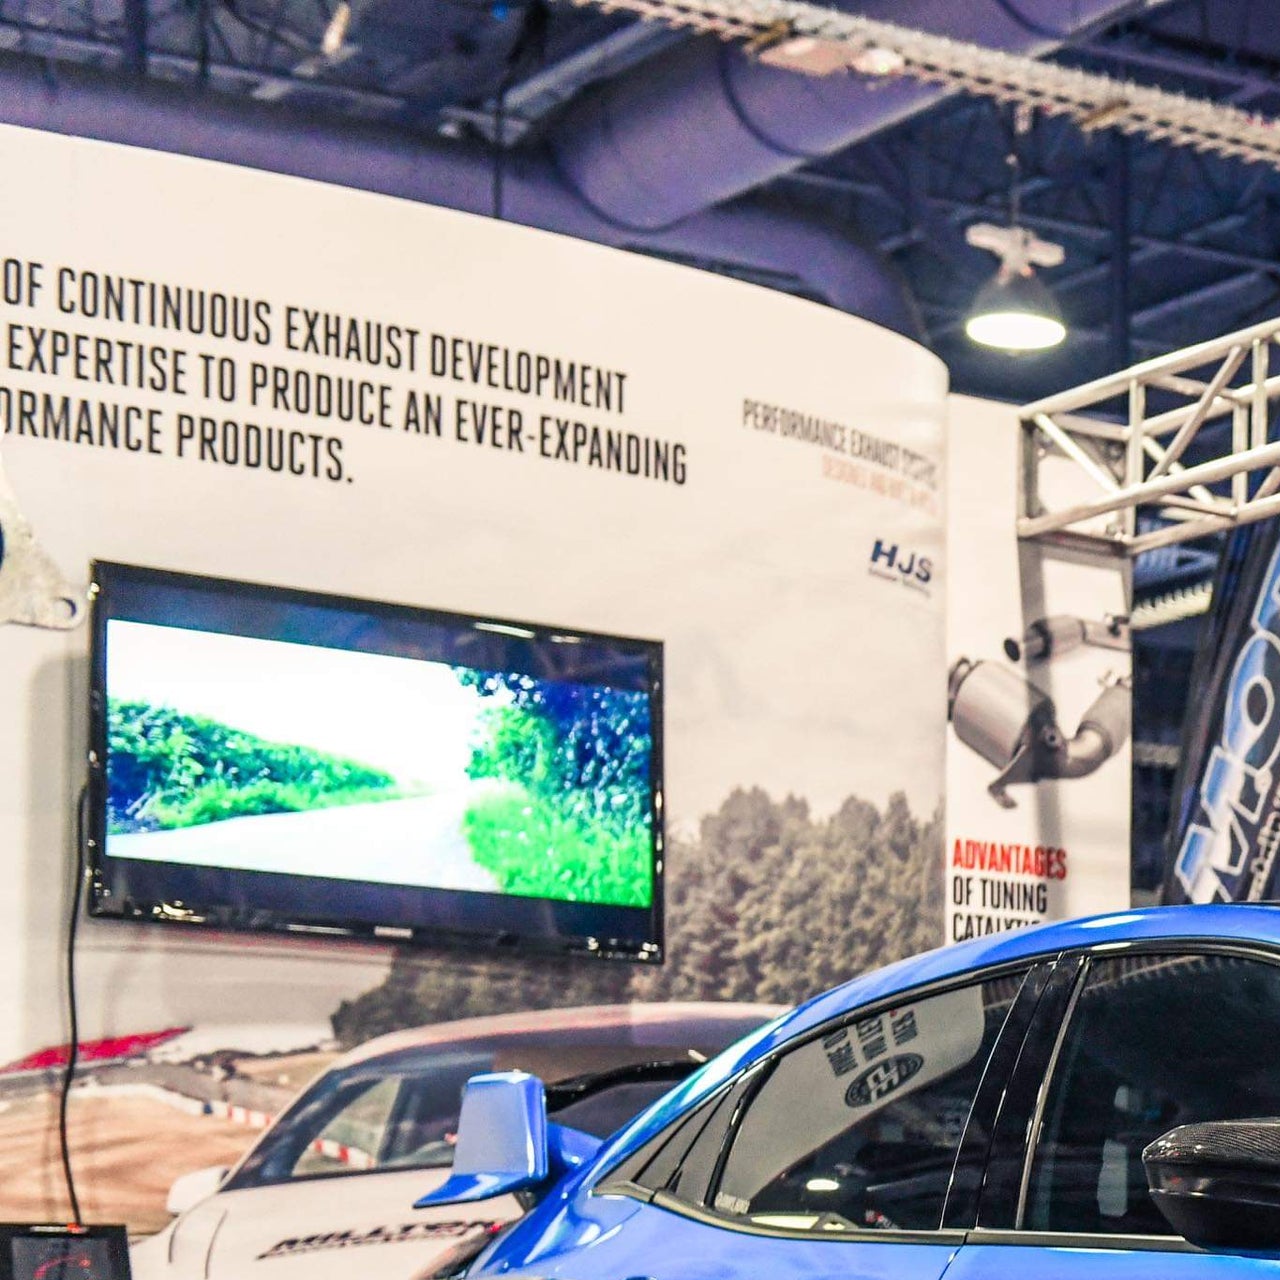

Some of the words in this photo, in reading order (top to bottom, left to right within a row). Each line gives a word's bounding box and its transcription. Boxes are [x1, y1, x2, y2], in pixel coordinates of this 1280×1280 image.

[3, 257, 43, 307] OF
[57, 266, 271, 346] CONTINUOUS
[285, 305, 420, 372] EXHAUST
[430, 332, 628, 414] DEVELOPMENT
[8, 323, 187, 395] EXPERTISE
[198, 353, 236, 403] TO
[250, 362, 393, 429] PRODUCE
[403, 390, 442, 437] AN
[455, 399, 687, 486] EVER-EXPANDING
[0, 386, 163, 455] ORMANCE
[176, 411, 354, 484] PRODUCTS.
[870, 538, 934, 584] HJS
[953, 837, 1067, 881] ADVANTAGES
[953, 875, 973, 906] OF
[979, 878, 1047, 914] TUNING
[953, 912, 1040, 943] CATALY
